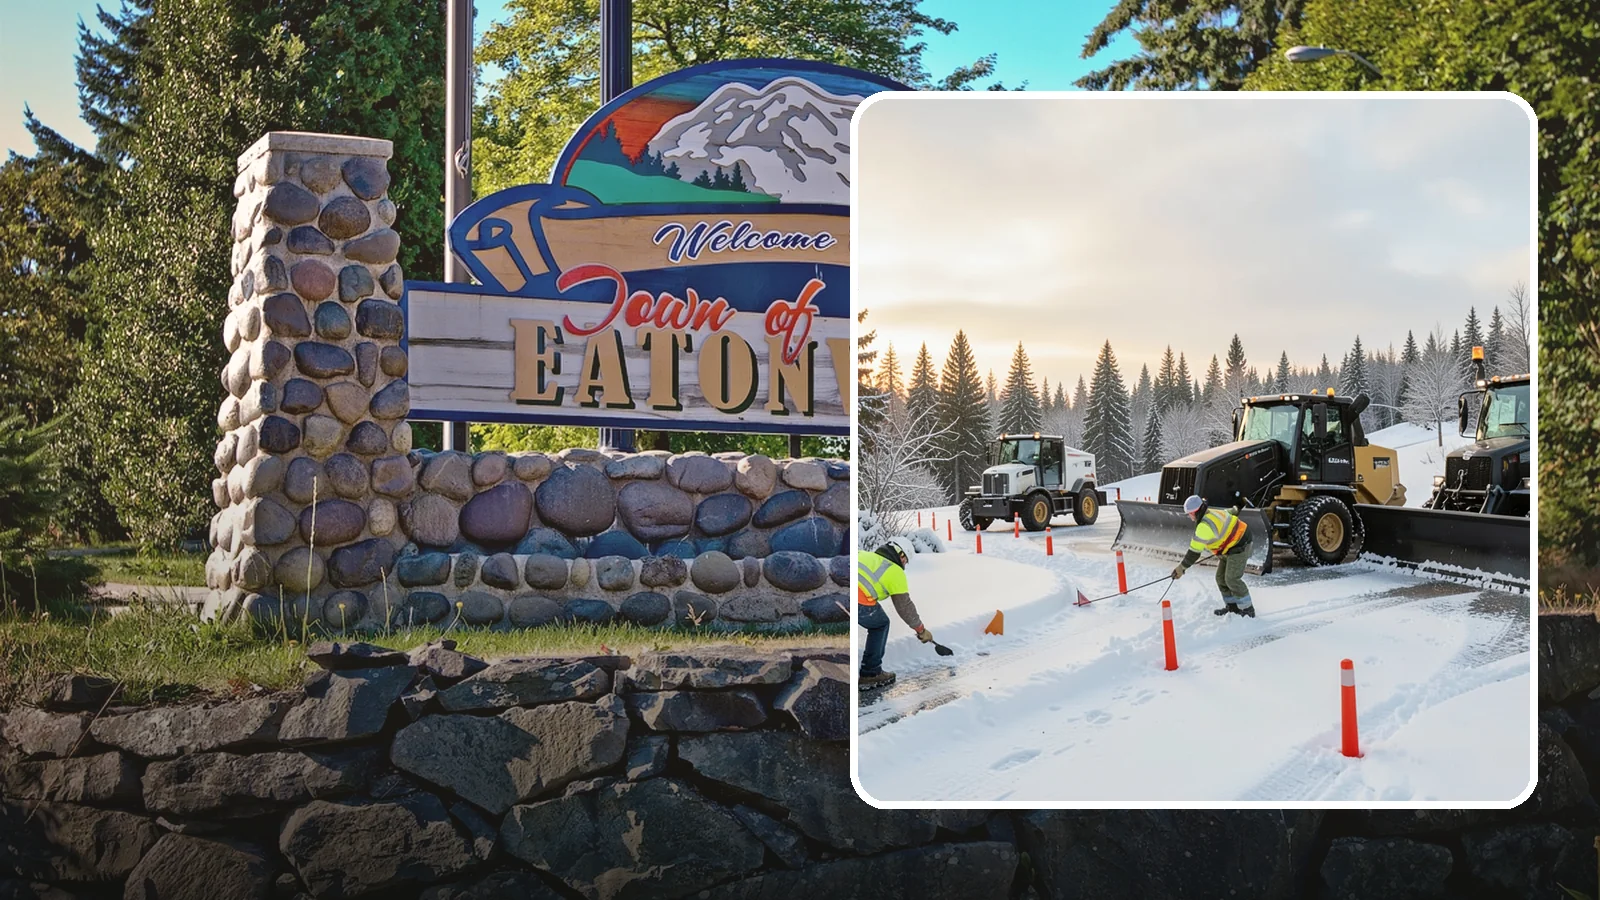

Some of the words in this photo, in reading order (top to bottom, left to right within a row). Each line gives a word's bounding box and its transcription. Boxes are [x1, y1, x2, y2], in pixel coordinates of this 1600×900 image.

[653, 220, 837, 263] Welcome
[557, 263, 737, 337] Town
[765, 278, 827, 365] of
